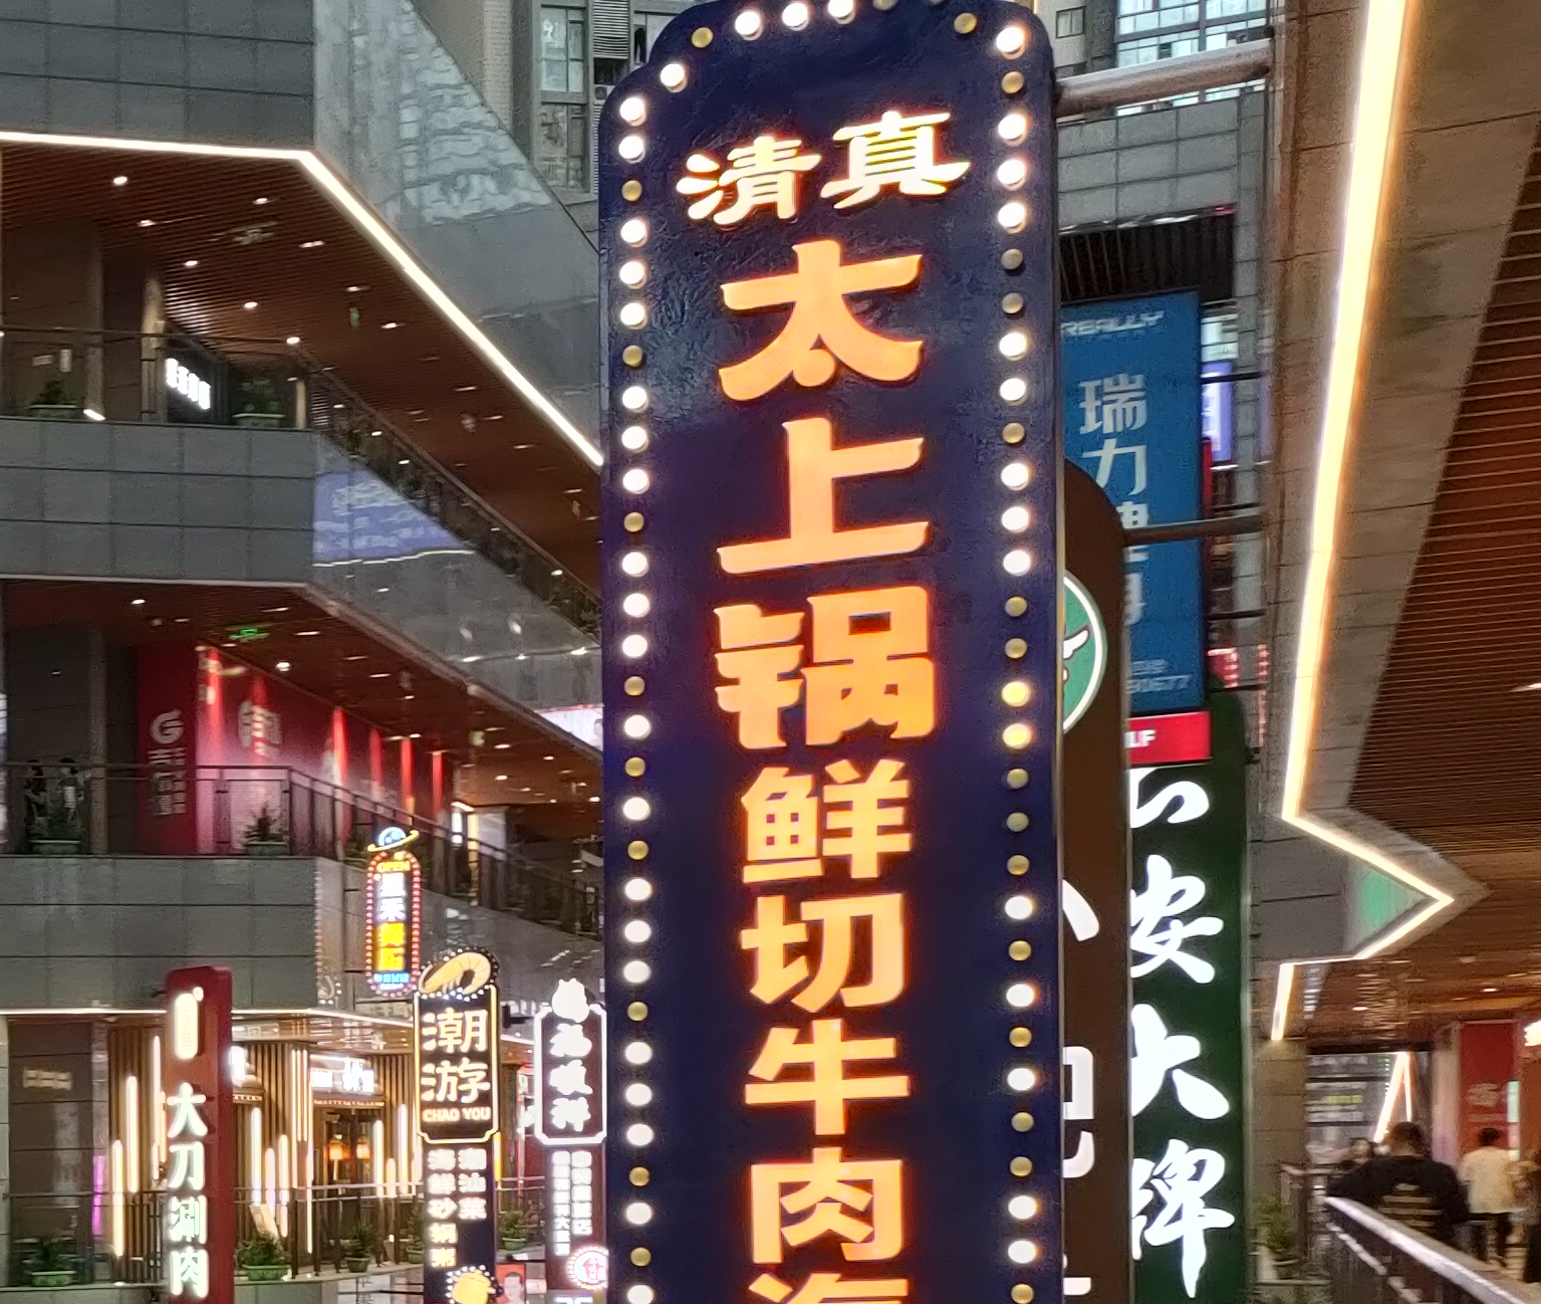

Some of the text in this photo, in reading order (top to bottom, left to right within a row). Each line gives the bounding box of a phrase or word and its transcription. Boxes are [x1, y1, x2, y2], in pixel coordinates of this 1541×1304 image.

[677, 110, 970, 226] 清真
[715, 240, 937, 749] 太上锅
[421, 1007, 491, 1104] 潮游
[422, 1106, 491, 1122] CHAO YOU
[167, 1083, 209, 1299] 大刀涮肉
